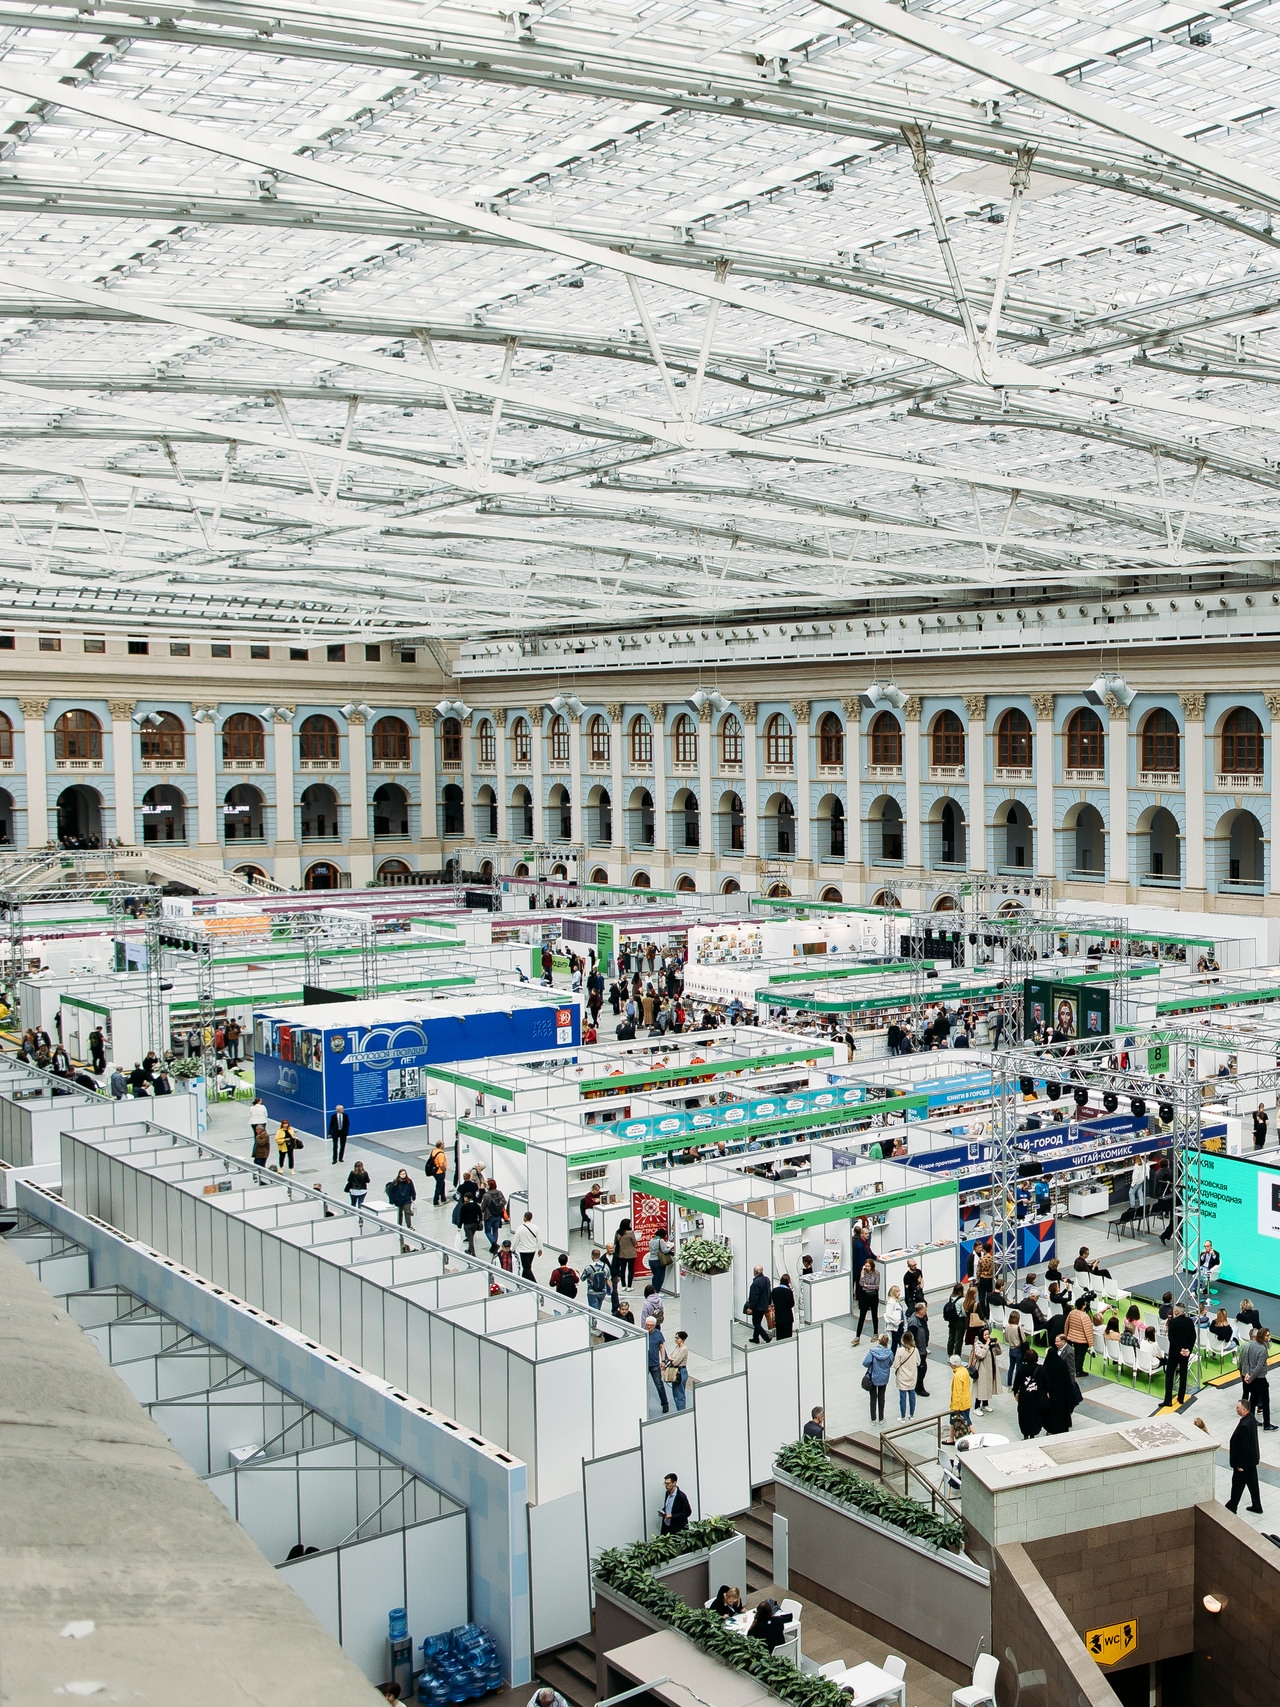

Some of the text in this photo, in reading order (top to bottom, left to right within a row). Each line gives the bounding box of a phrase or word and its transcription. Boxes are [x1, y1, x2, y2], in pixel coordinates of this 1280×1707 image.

[532, 1019, 553, 1029] 1922
[532, 1028, 553, 1038] 2022
[347, 1025, 428, 1072] 100
[1154, 1047, 1162, 1061] 8
[400, 1056, 417, 1065] ЛЕТ
[1150, 1061, 1167, 1070] сцена
[946, 1094, 965, 1102] КНИГИ
[969, 1089, 990, 1098] ГОРОДЕ
[1004, 1134, 1063, 1152] АЙ-ГОРОД
[1072, 1145, 1133, 1166] ЧИТАЙ-КОМИКС
[918, 1157, 961, 1170] Новое прочтение
[1183, 1174, 1228, 1191] оковская
[1183, 1194, 1217, 1209] ижная
[1104, 1634, 1120, 1646] WC
